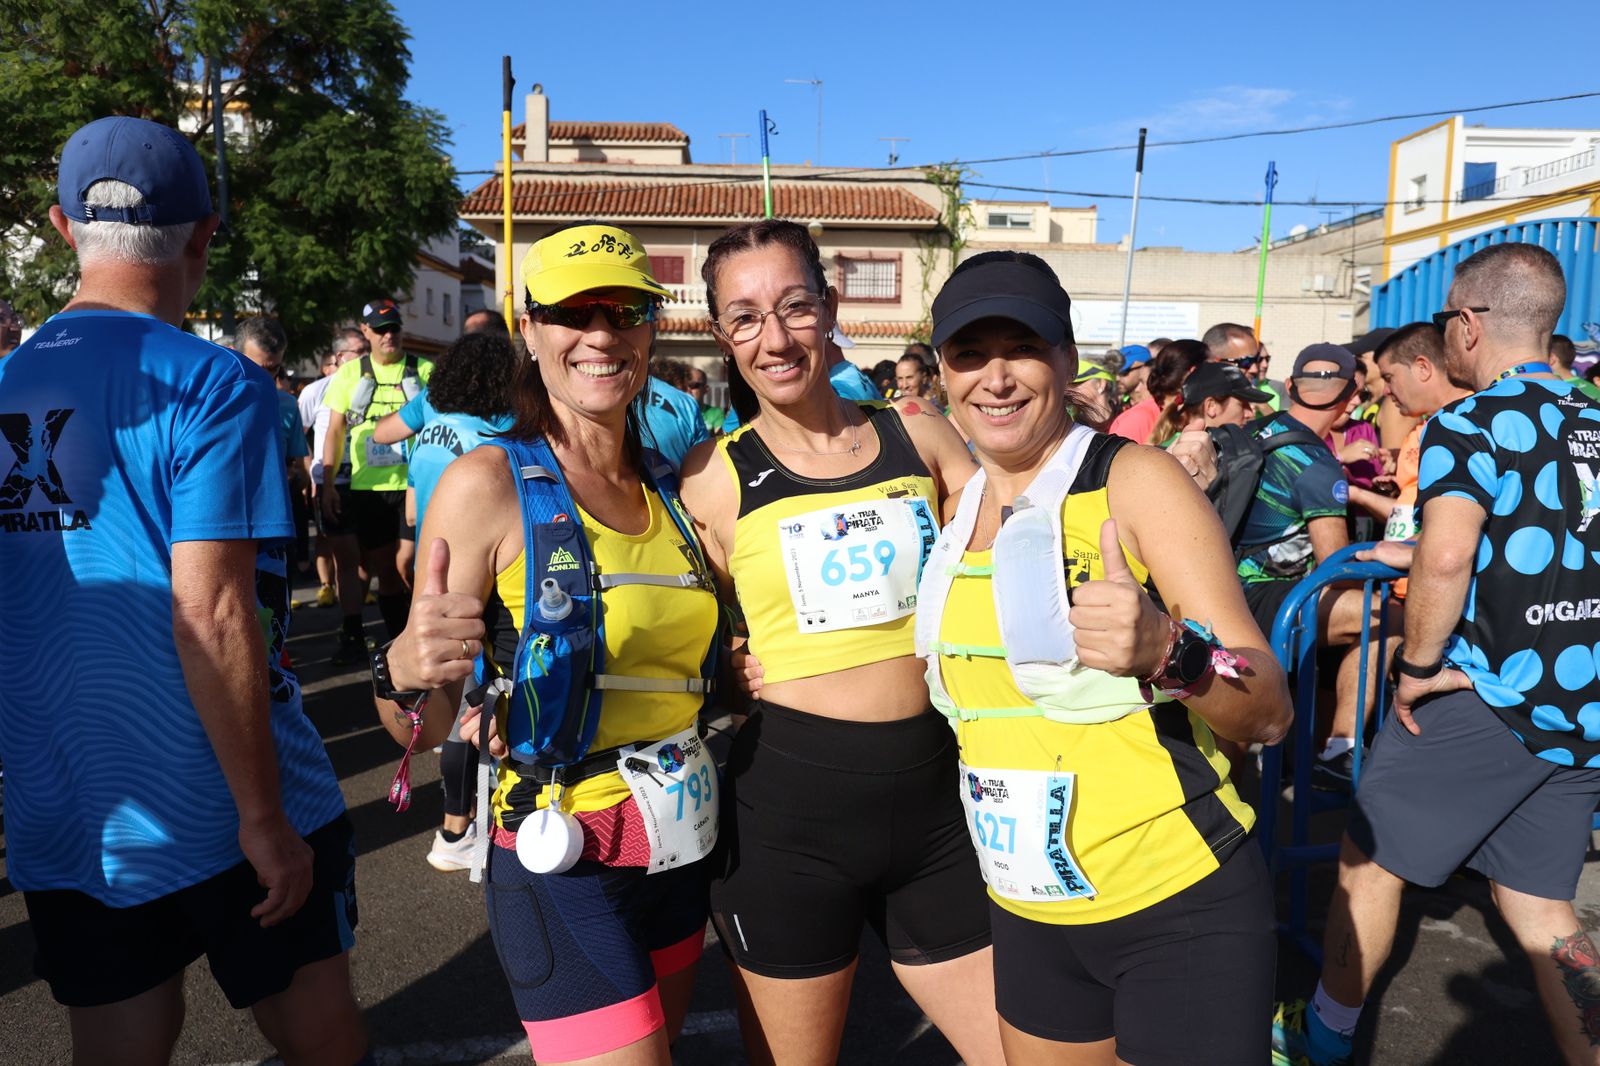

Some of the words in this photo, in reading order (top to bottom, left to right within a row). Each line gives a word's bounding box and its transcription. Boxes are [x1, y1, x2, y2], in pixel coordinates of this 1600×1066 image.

[34, 337, 83, 350] TEAMERGY
[877, 484, 898, 494] Vida
[845, 516, 884, 529] PIRATA
[1073, 549, 1100, 560] Sana
[547, 564, 580, 572] AONIJIE
[821, 540, 896, 587] 659
[853, 590, 880, 599] MANYA
[665, 764, 712, 822] 793
[975, 810, 1017, 854] 627
[1047, 785, 1085, 892] PIRATILLA
